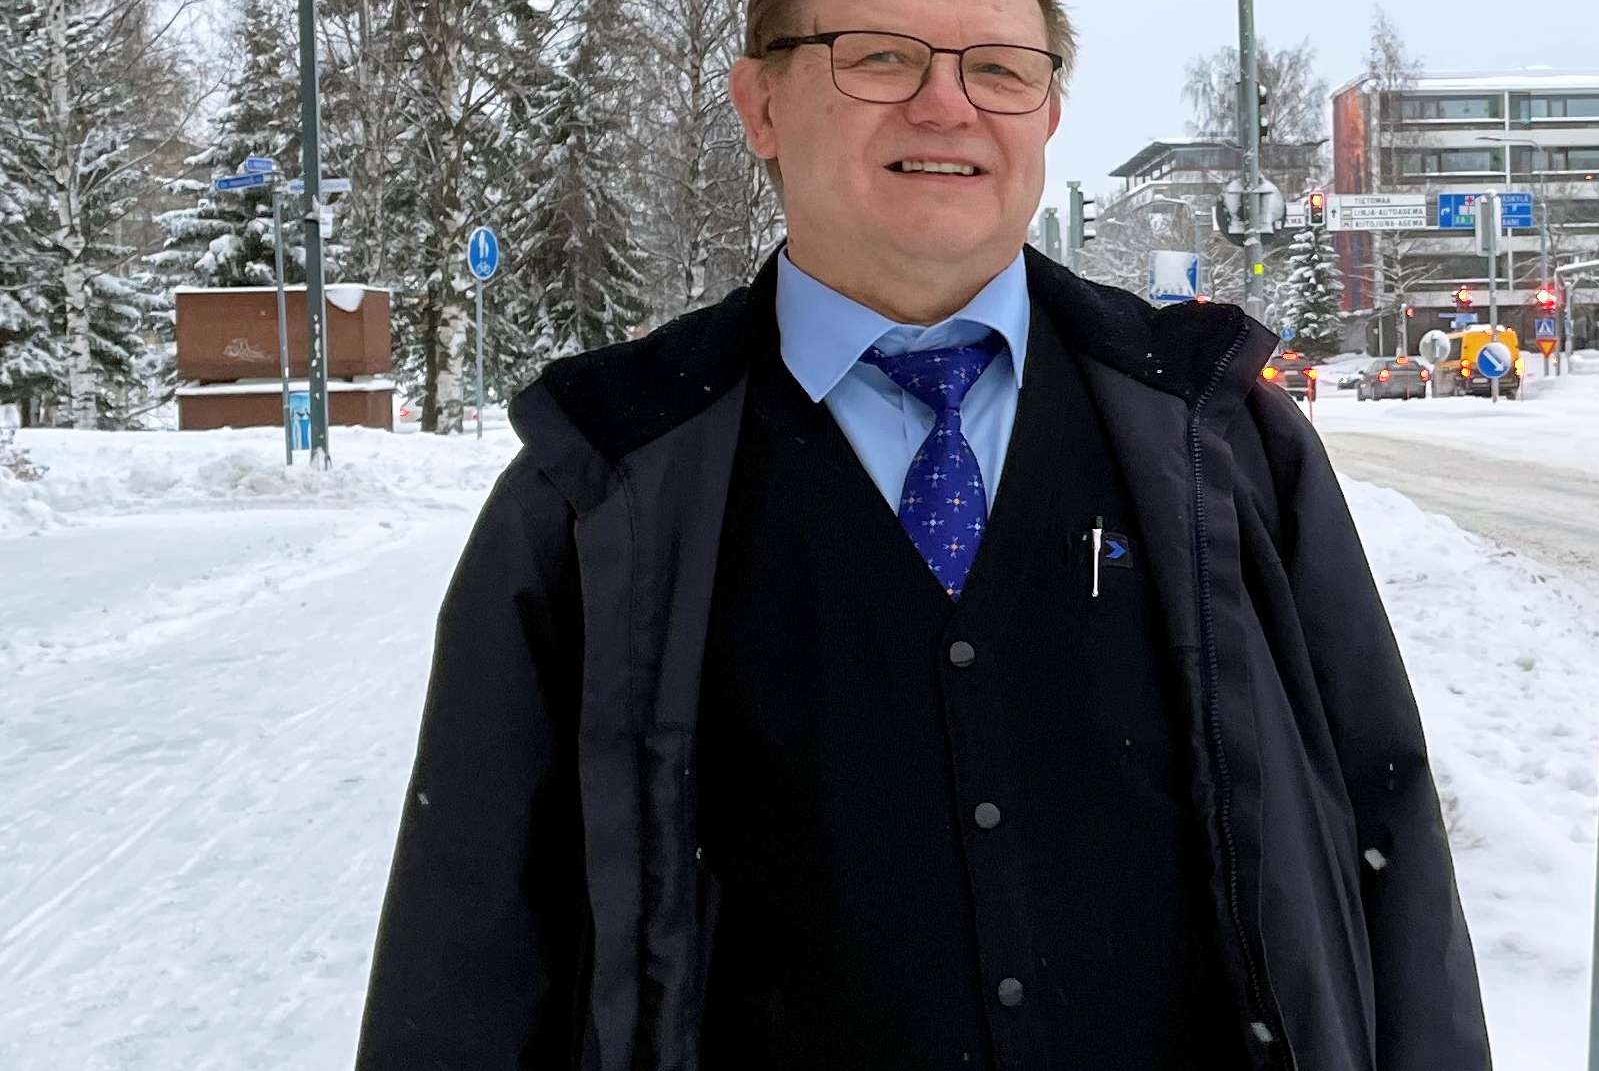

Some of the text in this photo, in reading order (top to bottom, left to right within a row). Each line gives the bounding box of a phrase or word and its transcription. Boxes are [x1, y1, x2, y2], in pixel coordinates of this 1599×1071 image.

[1354, 197, 1391, 205] TIETOMAA
[1354, 208, 1423, 216] LINJA-AUTOASEMA
[1355, 219, 1423, 227] AUTOJUNA-ASEMA
